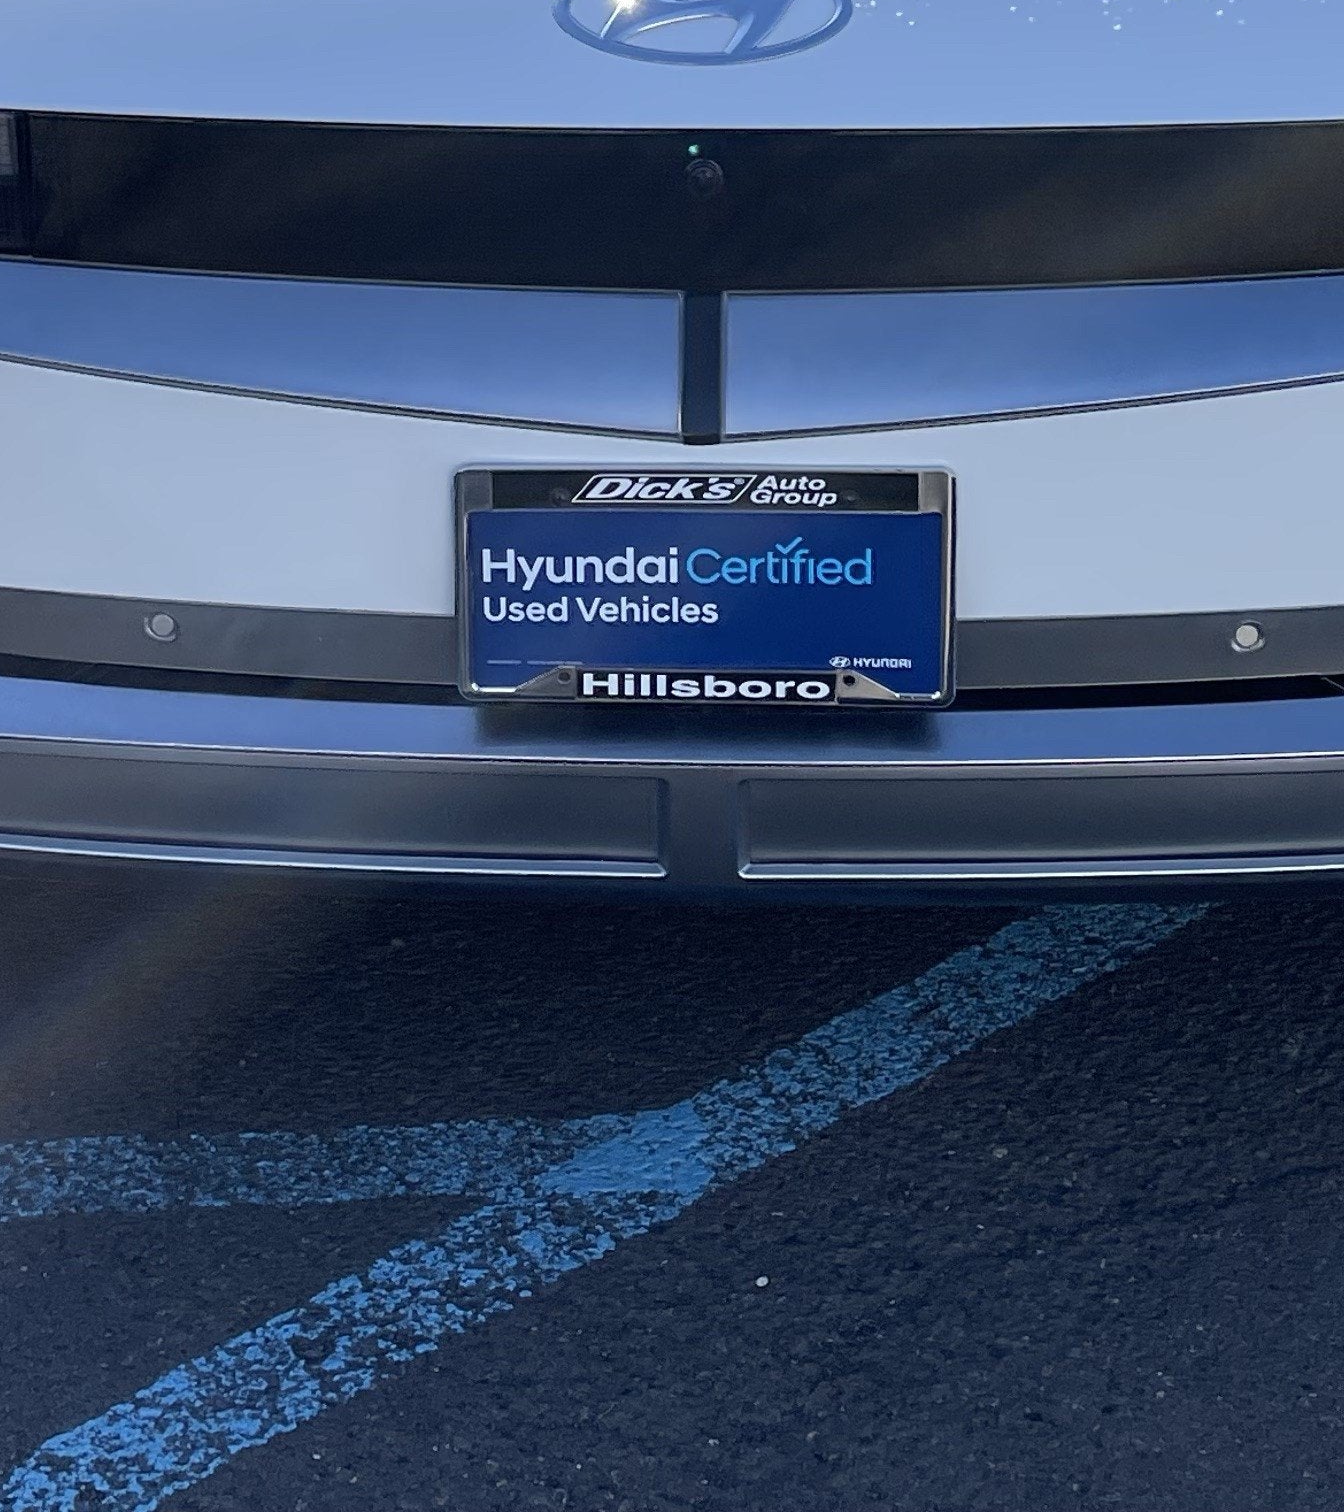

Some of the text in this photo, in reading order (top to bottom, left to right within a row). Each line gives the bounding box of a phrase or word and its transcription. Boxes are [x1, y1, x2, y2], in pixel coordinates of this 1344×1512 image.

[585, 476, 737, 500] Dick's
[756, 474, 827, 491] Auto
[749, 489, 838, 508] Group
[481, 537, 873, 592] Hyundai Certified
[482, 594, 719, 624] Used Vehicles
[582, 672, 831, 699] Hillsboro
